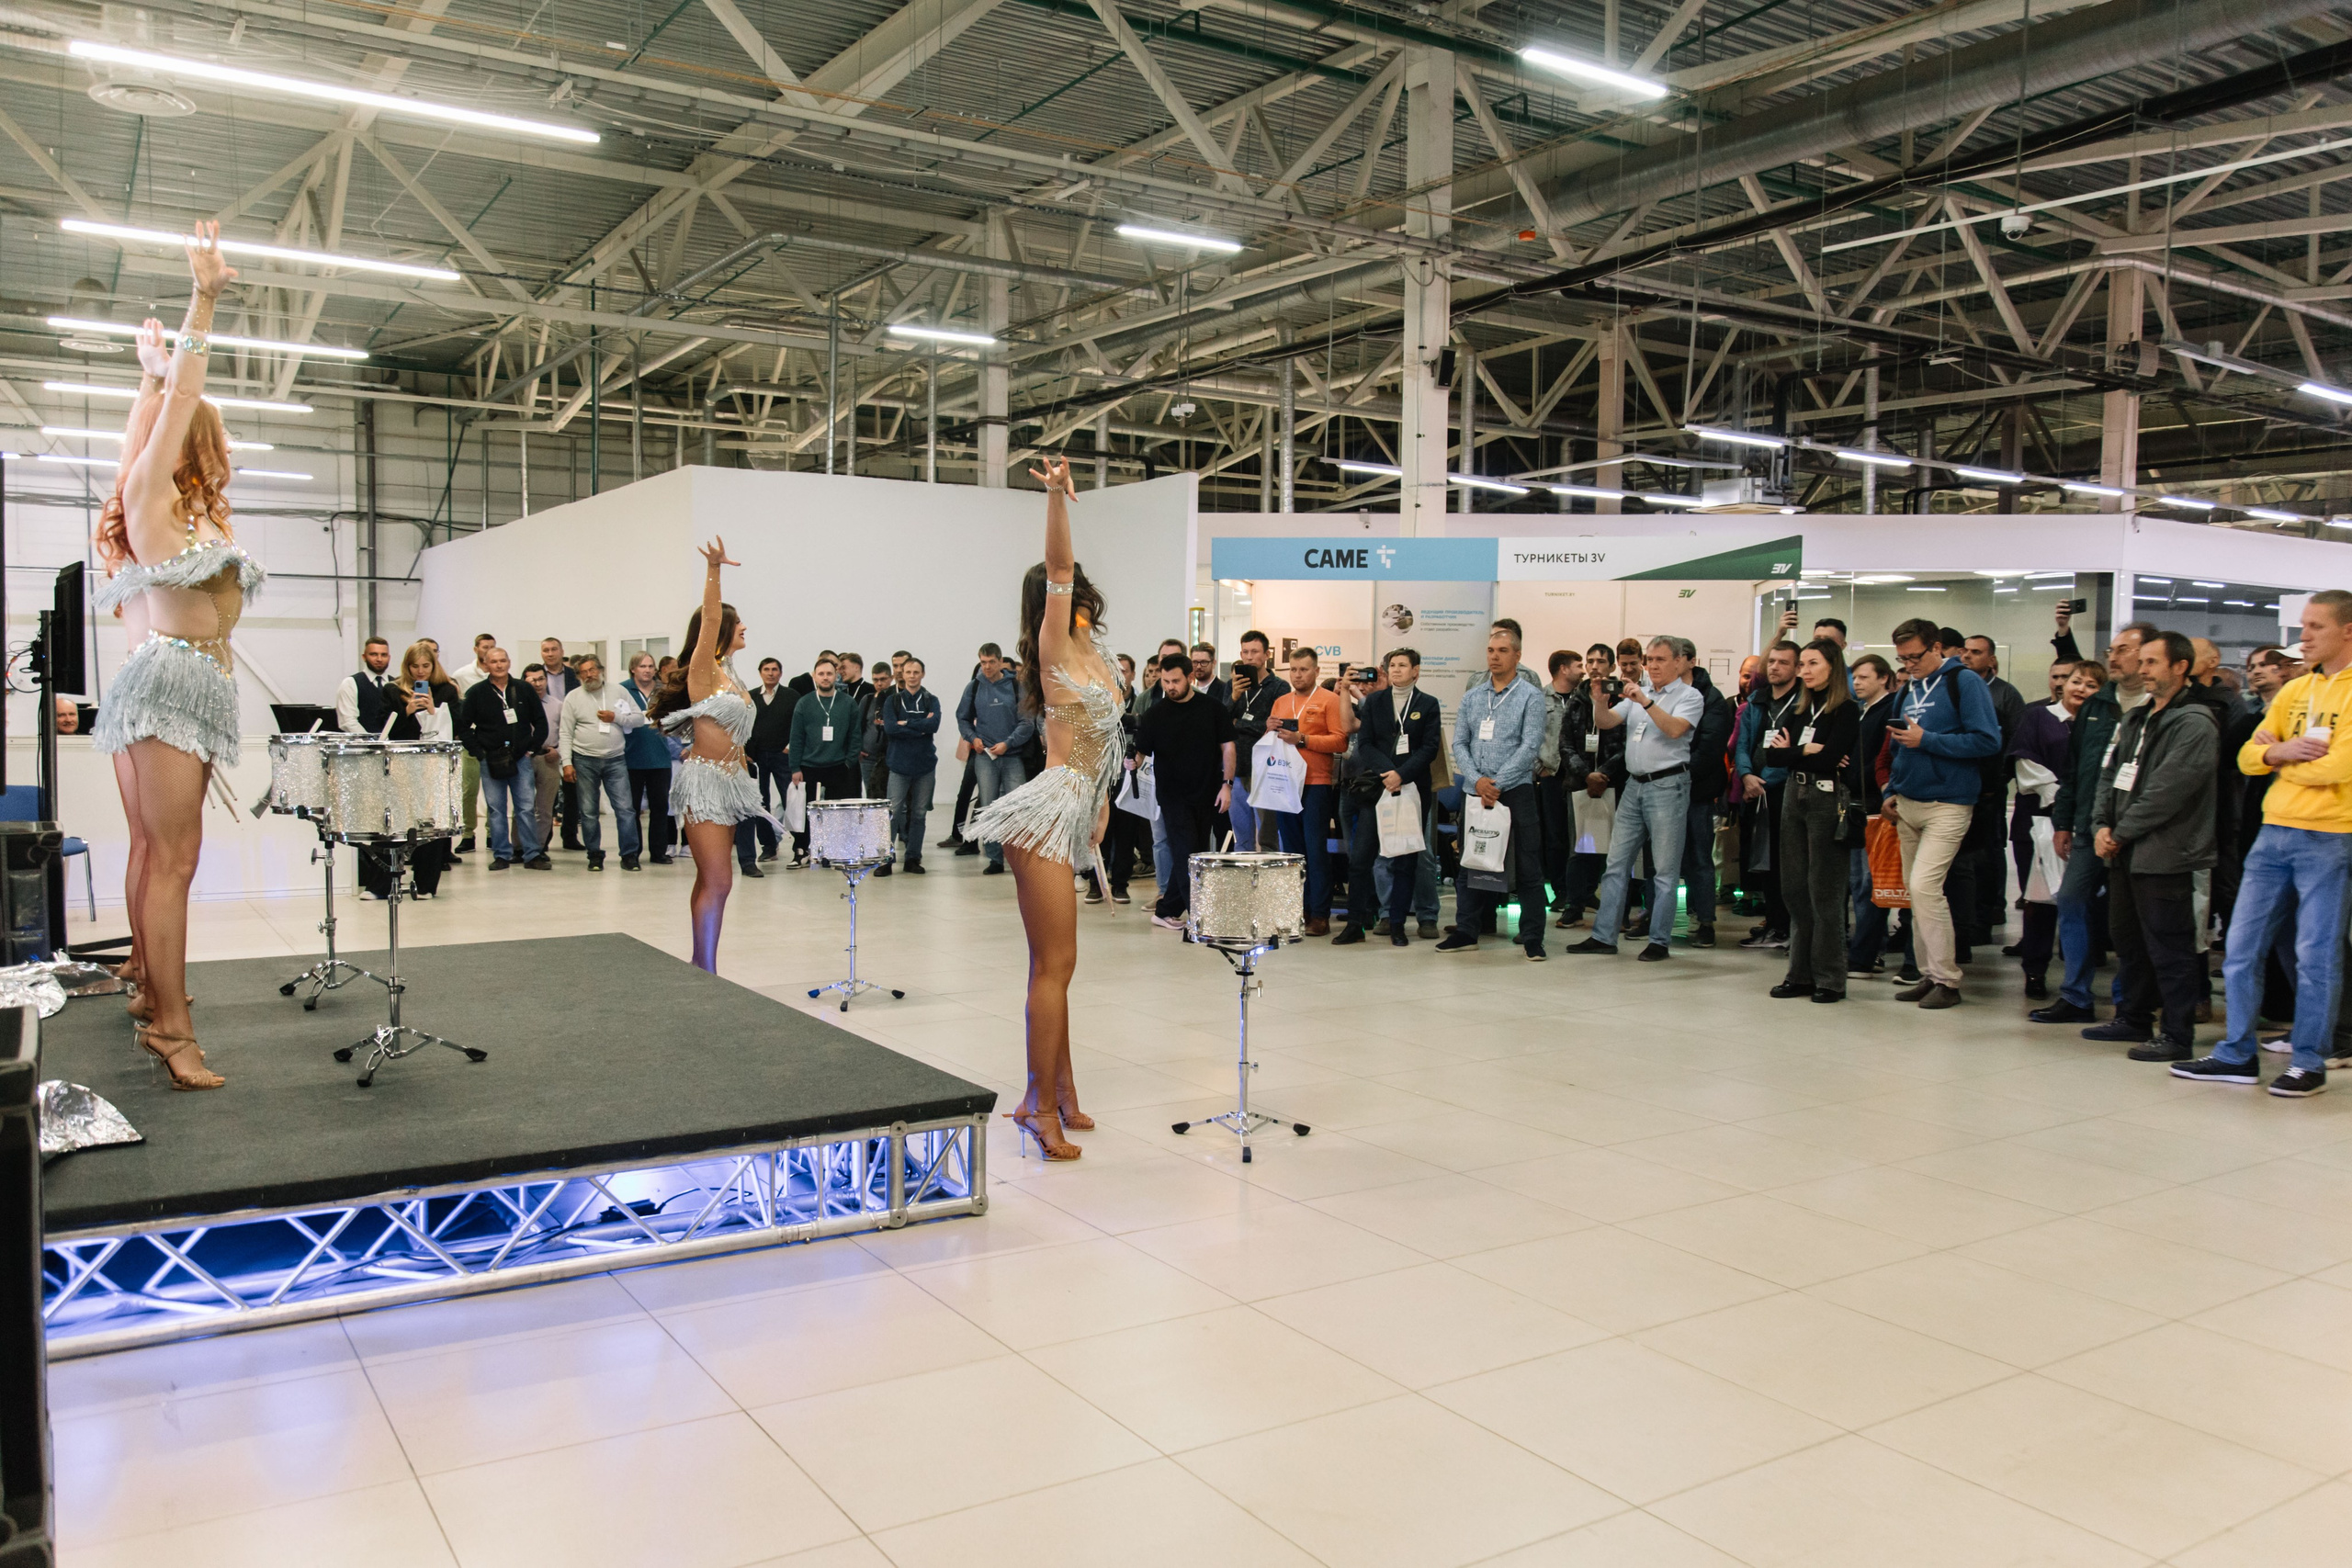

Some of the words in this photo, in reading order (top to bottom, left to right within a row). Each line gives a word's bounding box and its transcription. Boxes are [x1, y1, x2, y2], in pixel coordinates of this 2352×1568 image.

[1305, 548, 1368, 569] CAME
[1514, 553, 1588, 563] ТУРНИКЕТЫ
[1591, 553, 1606, 563] 3V
